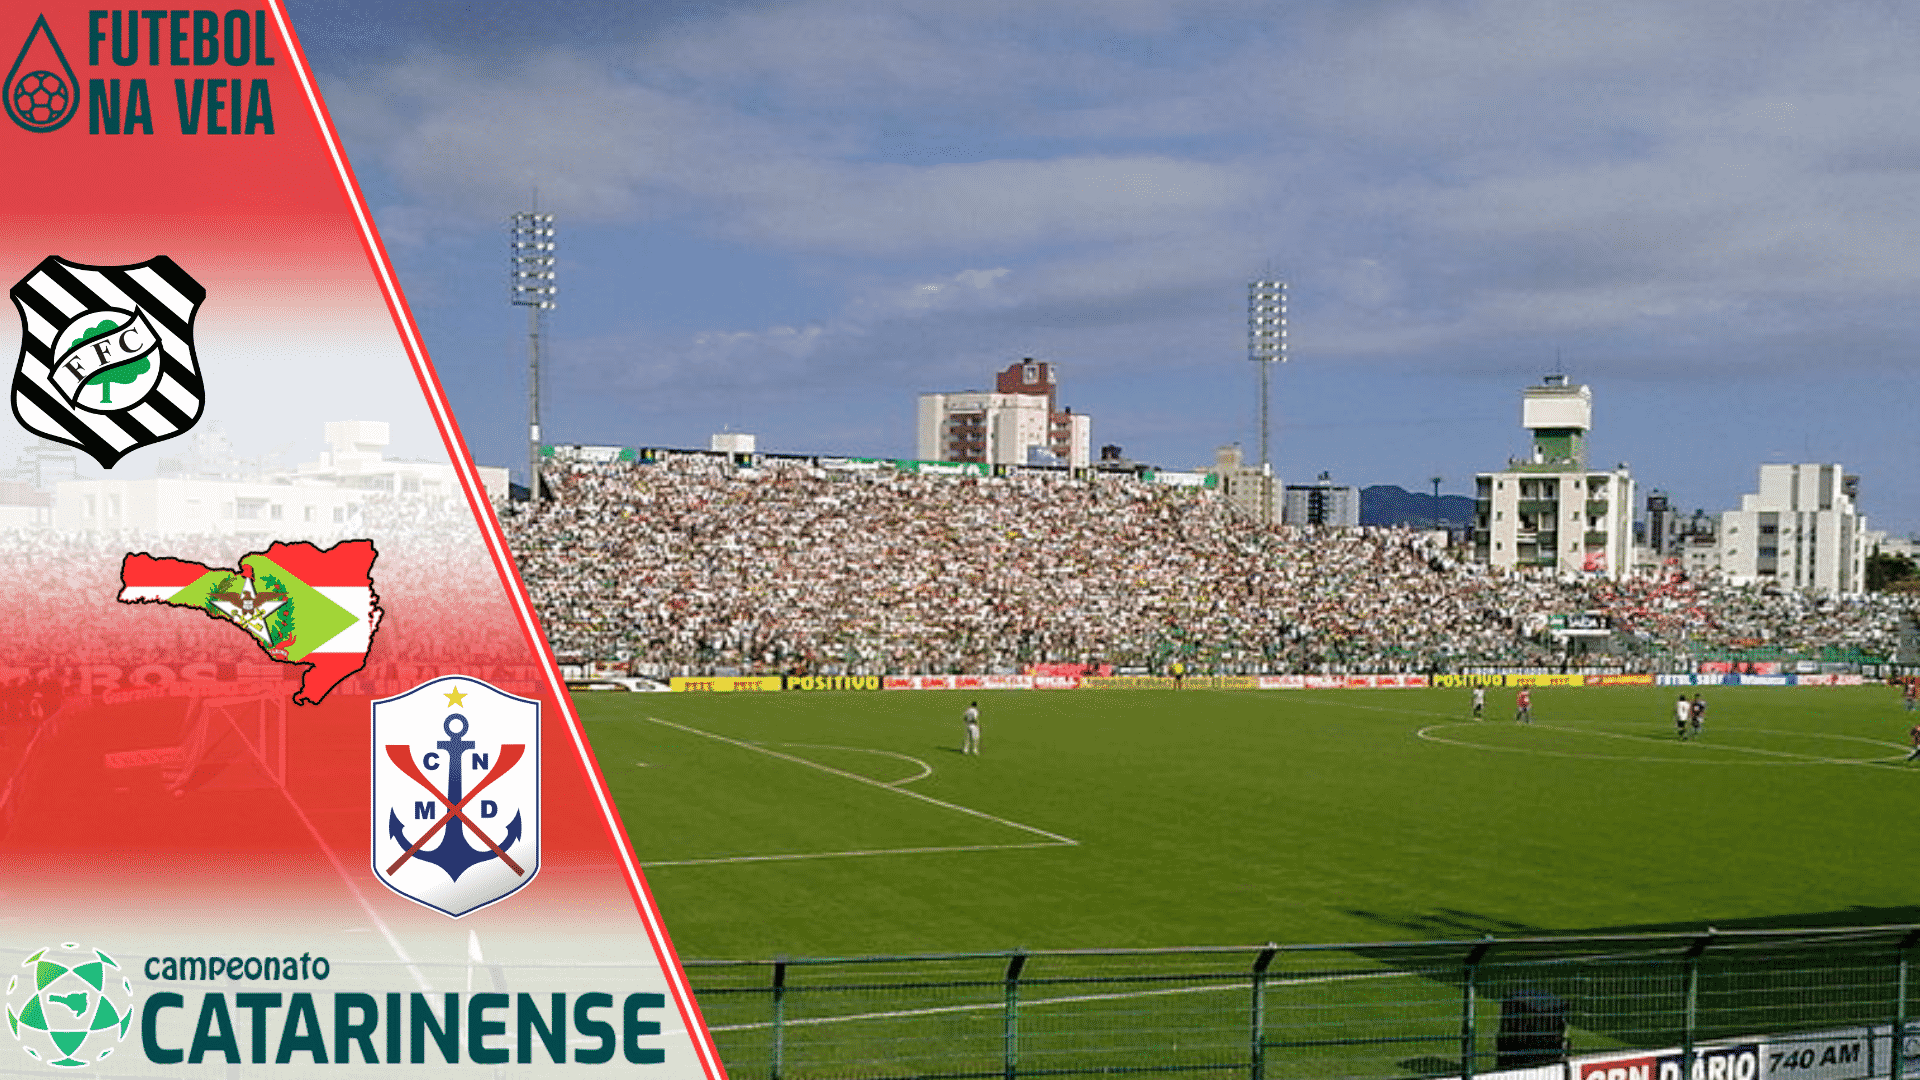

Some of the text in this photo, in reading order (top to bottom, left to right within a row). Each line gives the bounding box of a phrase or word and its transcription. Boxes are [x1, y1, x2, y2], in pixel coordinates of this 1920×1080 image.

[787, 676, 879, 690] POSITIVO
[1433, 674, 1502, 687] POSITIVO
[1769, 1049, 1815, 1073] 740
[1819, 1043, 1860, 1066] AM
